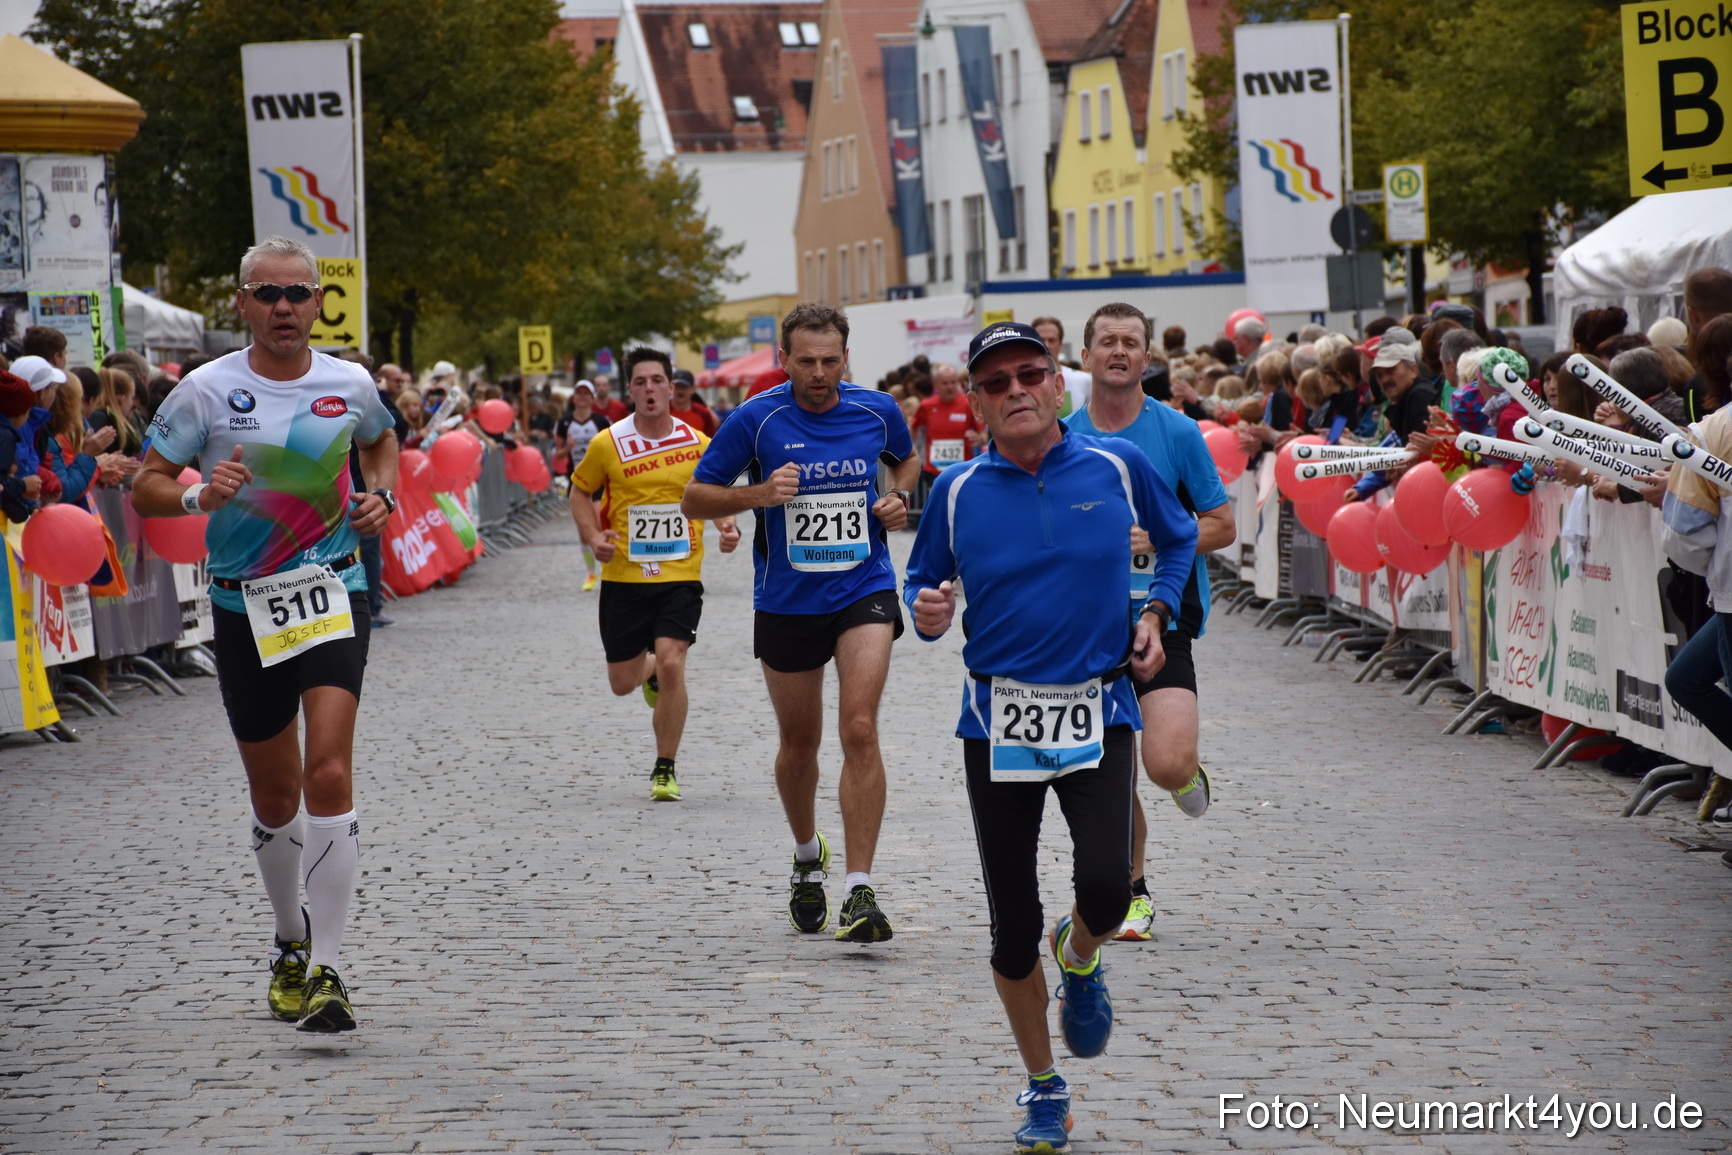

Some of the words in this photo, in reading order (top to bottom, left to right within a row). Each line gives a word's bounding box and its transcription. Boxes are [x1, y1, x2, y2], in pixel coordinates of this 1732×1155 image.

[1638, 3, 1732, 45] Block
[1658, 57, 1724, 151] B
[321, 262, 355, 278] lock
[320, 284, 346, 327] C
[528, 340, 544, 364] D
[1593, 378, 1632, 409] BMW
[229, 417, 260, 425] PARTL
[934, 448, 961, 459] 2432
[623, 459, 661, 479] MAX
[798, 459, 867, 480] YSCAD
[1324, 461, 1356, 476] BMW
[1701, 455, 1732, 484] BM
[652, 508, 678, 517] Neumarkt
[787, 502, 815, 510] PARTL
[816, 501, 855, 510] Neumarkt
[635, 517, 683, 540] 2713
[795, 511, 861, 542] 2213
[645, 543, 675, 553] Manuel
[804, 549, 855, 562] Wolfgang
[246, 586, 277, 597] PARTL
[278, 572, 325, 591] Neumarkt
[267, 585, 330, 627] 510
[276, 619, 332, 648] JOSEF
[994, 687, 1028, 699] PARTL
[1030, 690, 1083, 701] Neumarkt
[1003, 703, 1093, 743] 2379
[1033, 752, 1061, 768] Karl
